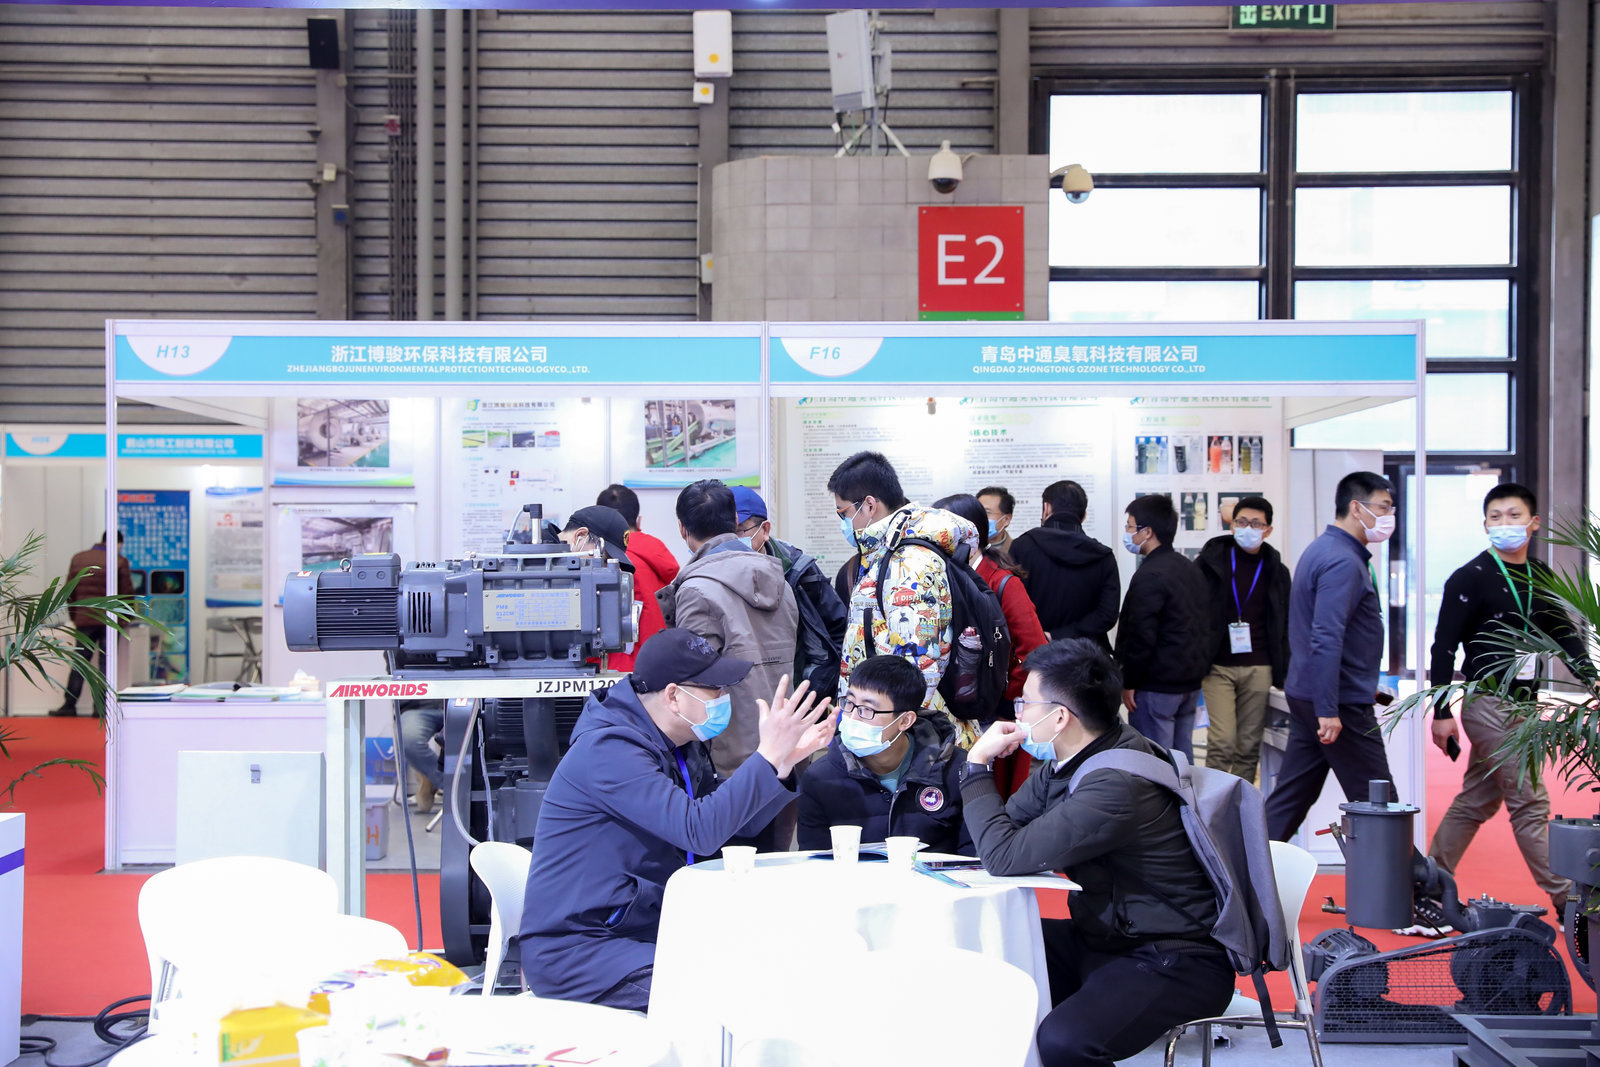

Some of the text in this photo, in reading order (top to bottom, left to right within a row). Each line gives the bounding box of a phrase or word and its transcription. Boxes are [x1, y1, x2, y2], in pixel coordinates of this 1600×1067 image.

[1261, 5, 1304, 21] EXIT
[937, 234, 1005, 286] E2
[156, 345, 191, 359] H13
[331, 345, 548, 364] 浙江博骏环保科技有限公司
[809, 346, 841, 360] F16
[981, 345, 1198, 363] 青岛中通臭氧科技有限公司
[972, 365, 1016, 374] QINGDAO
[1017, 365, 1075, 374] ZHONGTONG
[1076, 365, 1108, 374] OZONE
[1109, 365, 1170, 374] TECHNOLOGY
[329, 683, 429, 698] AIRWORIDS
